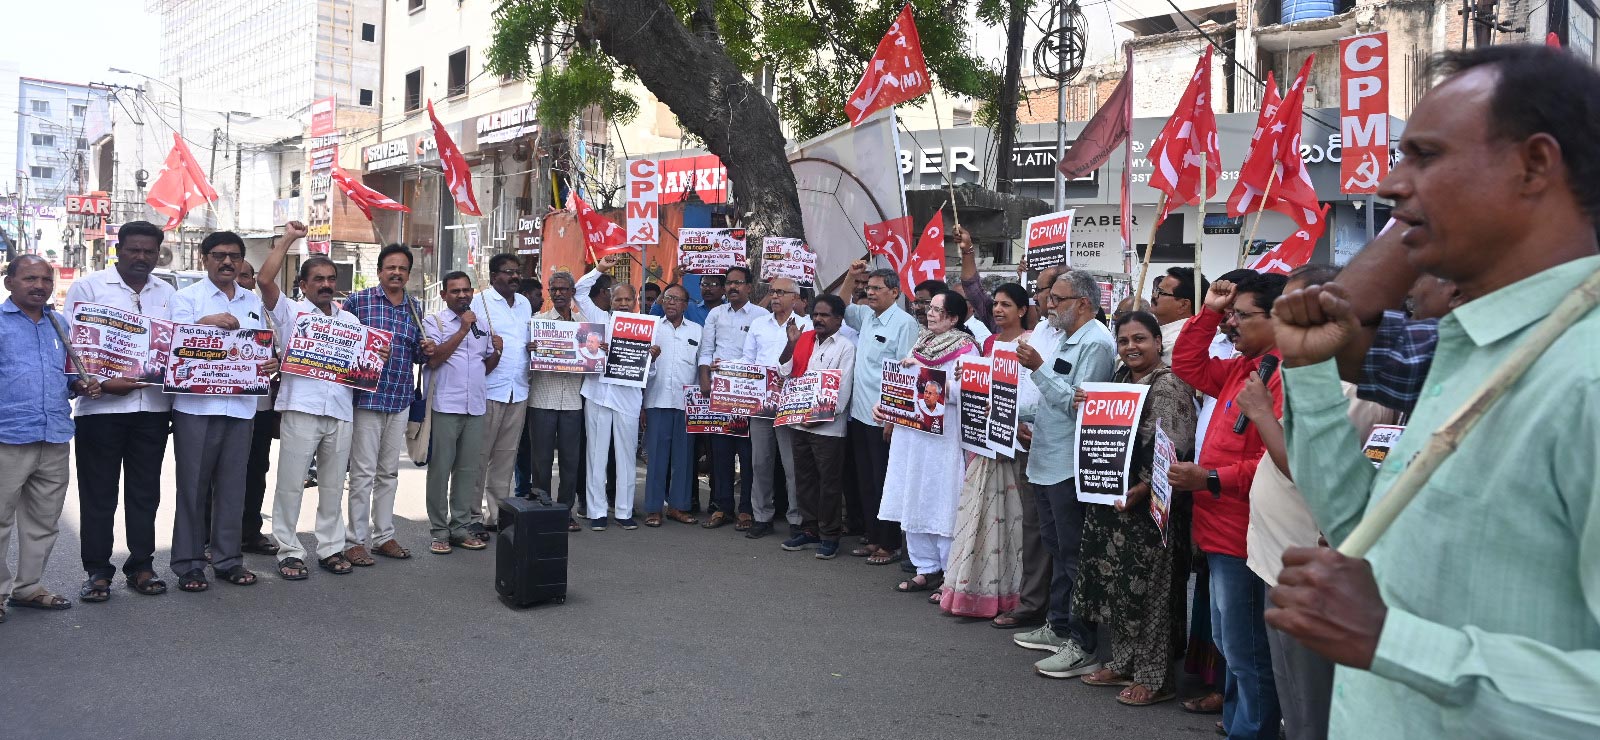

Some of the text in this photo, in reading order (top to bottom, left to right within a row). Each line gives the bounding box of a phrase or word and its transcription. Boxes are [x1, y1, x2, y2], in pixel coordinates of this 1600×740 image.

[1342, 38, 1386, 148] CPM
[899, 146, 980, 174] BER
[1012, 152, 1057, 168] PLATIN
[658, 167, 726, 194] RANKE
[628, 160, 657, 218] CPM
[68, 198, 110, 214] BAR
[518, 218, 534, 234] Day
[1031, 222, 1066, 240] CPI(M)
[524, 236, 540, 245] TEAC
[542, 322, 556, 330] THIS
[615, 321, 653, 337] CPI(M)
[534, 329, 574, 340] DEMOCRACY?
[293, 339, 314, 350] BJP
[318, 371, 336, 380] CPM
[994, 358, 1018, 379] CPI(M)
[882, 371, 916, 386] DEMOCRACY?
[962, 369, 989, 388] CPI(M
[1085, 399, 1136, 420] CPI(M)
[1097, 429, 1130, 438] democracy?
